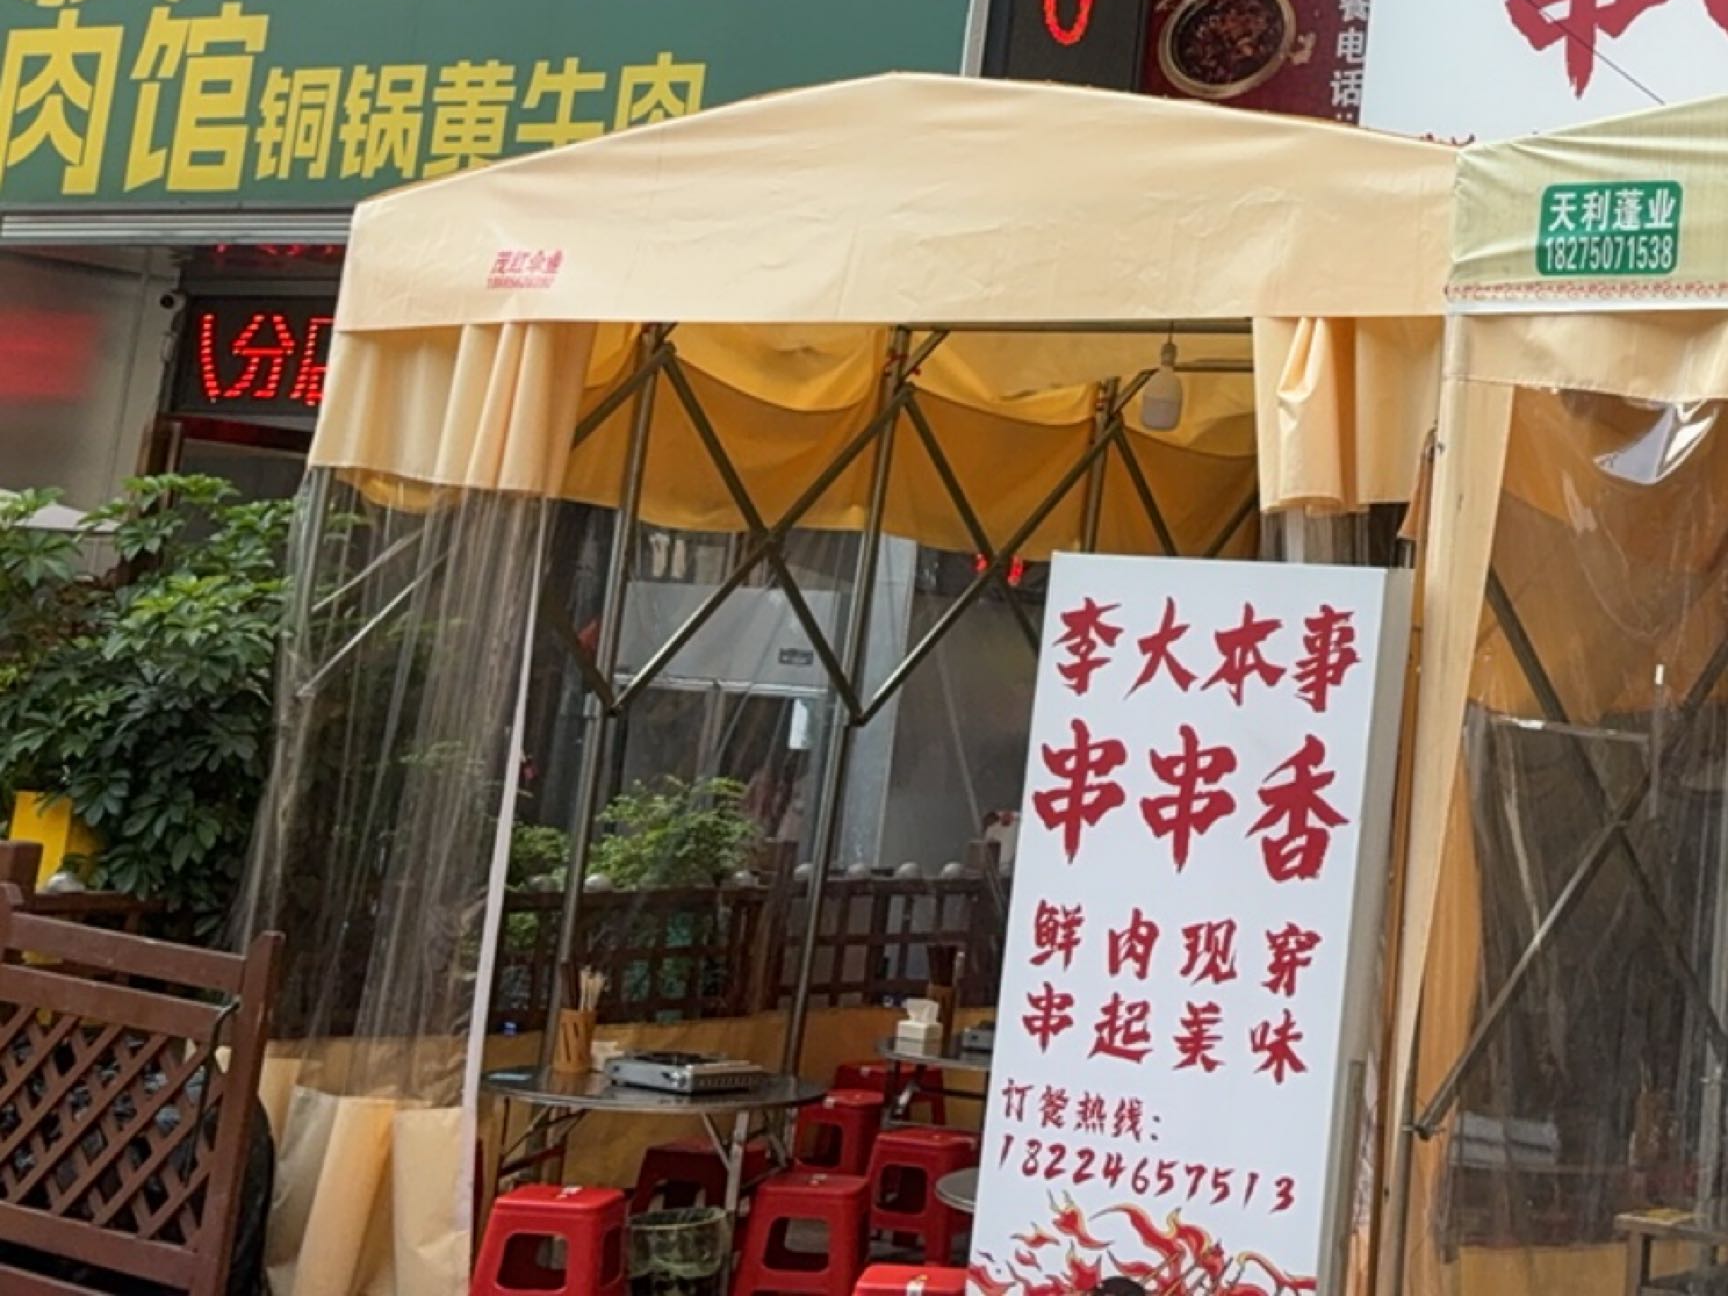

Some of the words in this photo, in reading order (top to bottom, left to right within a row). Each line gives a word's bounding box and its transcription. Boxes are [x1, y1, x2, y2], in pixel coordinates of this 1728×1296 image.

[0, 2, 269, 194] 肉馆
[255, 52, 706, 181] 铜锅黄牛肉
[1545, 234, 1673, 271] 18275071538
[1548, 188, 1676, 231] 天利蓬业
[1051, 597, 1362, 712] 李大本事
[1032, 718, 1350, 882] 串串香
[1029, 899, 1322, 997] 鲜肉现穿
[1022, 981, 1308, 1084] 串起美味
[999, 1134, 1296, 1214] 18224657513
